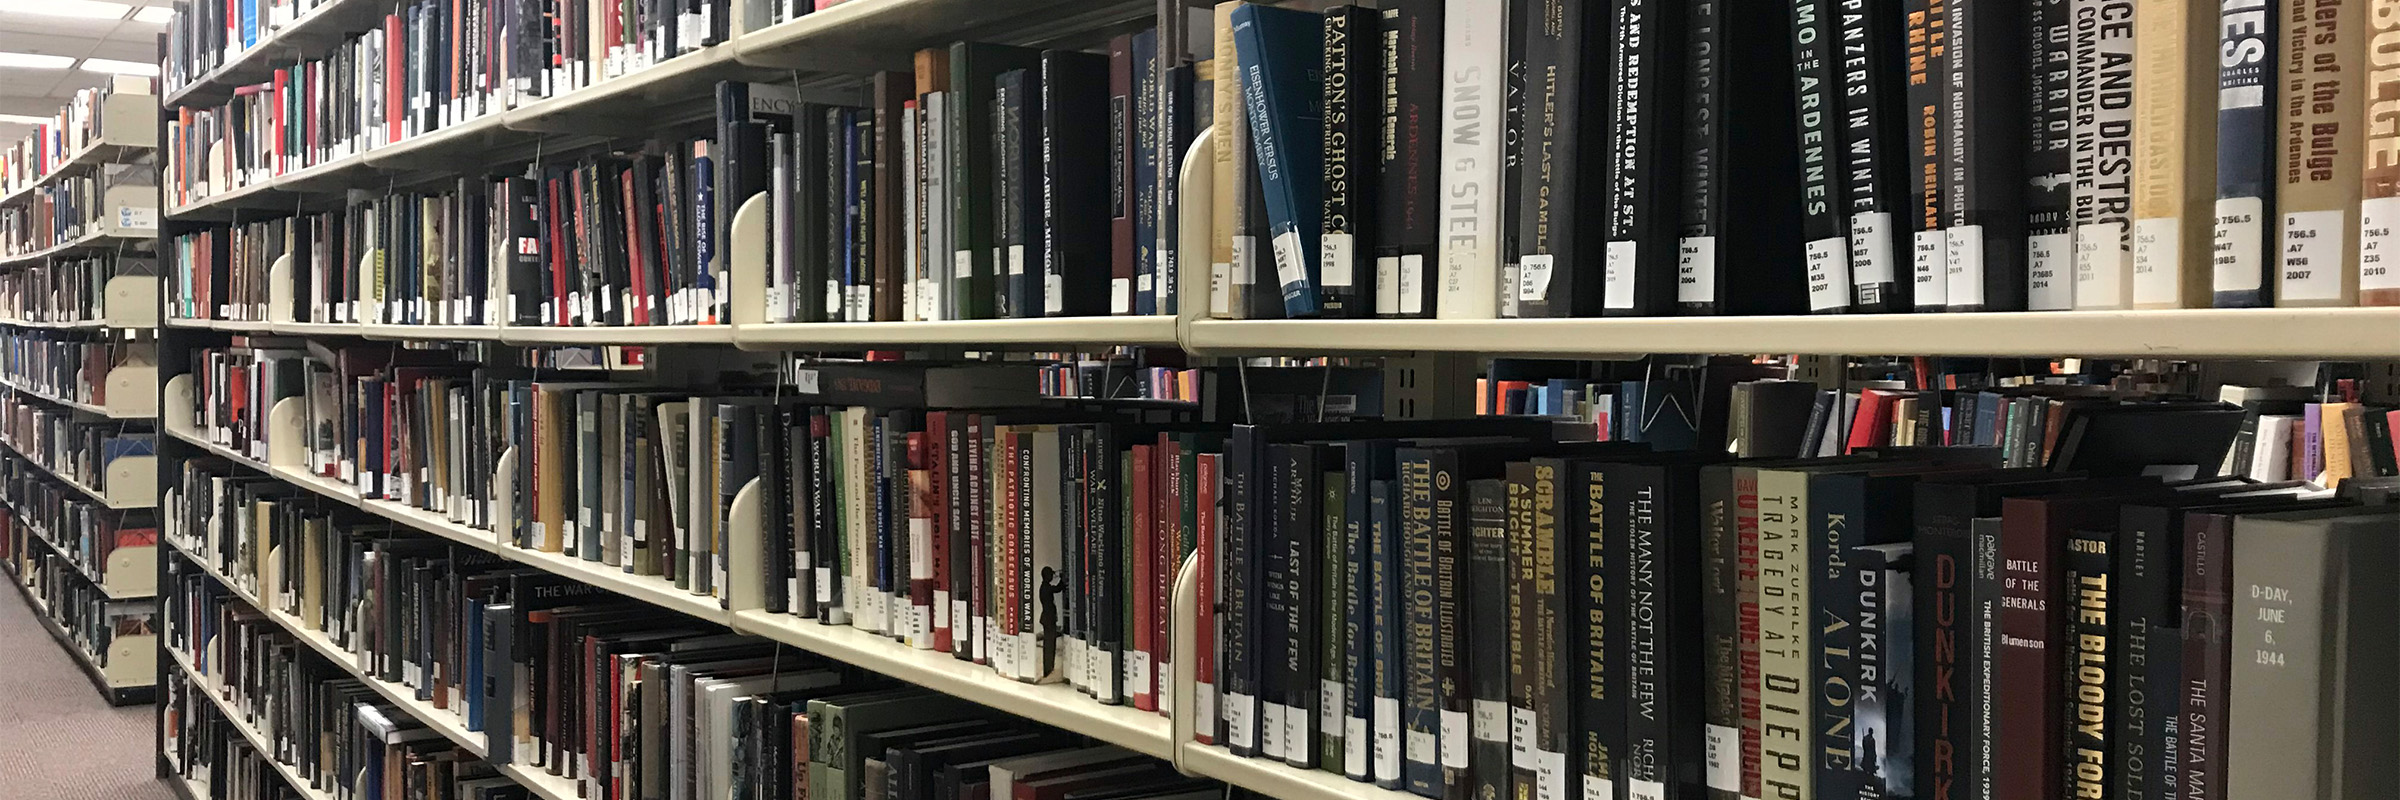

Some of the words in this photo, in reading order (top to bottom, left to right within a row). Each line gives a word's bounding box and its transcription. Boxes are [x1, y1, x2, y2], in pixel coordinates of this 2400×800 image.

[1629, 13, 1641, 48] AND
[2033, 9, 2042, 21] SS
[2293, 0, 2307, 21] and
[1324, 17, 1332, 74] CRACKING
[1388, 30, 1398, 73] Marshall
[1801, 50, 1813, 58] IN
[1841, 0, 1867, 96] PANZERS
[1909, 10, 1926, 86] RHINE
[1952, 7, 1963, 66] INVASION
[2032, 25, 2042, 70] COLONEL
[2290, 26, 2307, 74] Victory
[1218, 25, 1233, 115] MONTY'S
[1331, 14, 1346, 123] PATTON'S
[1798, 60, 1819, 70] THE
[1952, 71, 1964, 87] OF
[2076, 6, 2096, 126] COMMANDER
[2100, 52, 2133, 110] AND
[2222, 67, 2260, 78] CHARLES
[2223, 77, 2258, 85] WHITING
[2314, 52, 2340, 72] of
[1324, 75, 1332, 96] THE
[1387, 95, 1396, 114] His
[1388, 75, 1397, 93] and
[1543, 65, 1556, 138] HITLER'S
[2032, 73, 2042, 112] JOCHEN
[2049, 24, 2069, 152] WARRIOR
[2291, 79, 2304, 91] in
[2312, 79, 2340, 114] the
[2369, 0, 2400, 170] BULGE
[1249, 64, 1270, 134] EISENHOWER
[1263, 134, 1278, 181] VERSUS
[1324, 97, 1332, 153] SIEGFRIED
[1452, 65, 1481, 146] SNOW
[1506, 60, 1520, 168] VALOR
[1624, 54, 1639, 170] REDEMPTION
[1850, 108, 1869, 129] IN
[2290, 95, 2306, 116] the
[1217, 123, 1232, 163] MEN
[1245, 87, 1265, 167] MONTGOMERY
[1386, 115, 1396, 161] Generals
[1800, 77, 1826, 216] ARDENNES
[1924, 105, 1936, 156] ROBIN
[1952, 90, 1964, 164] NORMANDY
[2032, 116, 2042, 152] PEIPER
[2076, 131, 2094, 152] IN
[1330, 131, 1346, 206] GHOST
[1540, 140, 1551, 182] LAST
[2076, 155, 2093, 189] THE
[2289, 120, 2304, 184] Ardennes
[2307, 121, 2338, 181] Bulge
[1624, 175, 1635, 200] AT
[1851, 139, 1873, 213] WINTE
[1953, 167, 1964, 181] IN
[1924, 164, 1937, 231] NEILLAN
[1449, 182, 1478, 257] STEE
[1537, 186, 1549, 255] GAMBLE
[1621, 204, 1634, 235] ST.
[2288, 230, 2316, 238] 756.5
[2289, 217, 2295, 226] D
[2364, 228, 2389, 236] 756.5
[2287, 244, 2302, 252] .A7
[2287, 258, 2308, 266] W56
[2364, 242, 2378, 250] .A7
[2286, 271, 2310, 280] 2007
[2364, 268, 2385, 276] 2010
[813, 440, 822, 484] WORLD
[1022, 449, 1030, 506] CONFRONTING
[1590, 472, 1603, 482] THE
[1438, 500, 1452, 540] BATTLE
[1590, 484, 1604, 568] BATTLE
[1638, 486, 1652, 524] THE
[1790, 496, 1798, 552] MARK
[1022, 510, 1030, 554] MEMORIES
[1438, 542, 1451, 554] OF
[1535, 466, 1554, 594] SCRAMBLE
[1826, 512, 1846, 580] Korda
[2068, 538, 2106, 554] ASTOR
[1023, 556, 1030, 566] OF
[1289, 540, 1300, 576] LAST
[1638, 531, 1652, 586] MANY
[1763, 496, 1784, 616] TRAGEDY
[1978, 534, 1986, 579] macmillan
[1986, 534, 1996, 580] palgrave
[2006, 559, 2038, 572] BATTLE
[2135, 530, 2145, 577] HARTLEY
[2197, 532, 2206, 576] CASTILLO
[535, 586, 560, 598] THE
[564, 584, 592, 596] WAR
[1288, 580, 1299, 599] OF
[1439, 556, 1454, 599] BRITAIN
[1590, 574, 1604, 605] OF
[2006, 578, 2016, 590] OF
[2022, 579, 2039, 591] THE
[2252, 585, 2293, 604] D-DAY,
[1288, 602, 1298, 626] THE
[1639, 590, 1653, 634] NOT
[1790, 564, 1800, 660] ZUEHLKE
[2002, 596, 2045, 611] GENERALS
[2080, 574, 2107, 625] THE
[2258, 608, 2284, 622] JUNE
[1288, 630, 1298, 671] FEW
[1590, 610, 1604, 700] BRITAIN
[1640, 636, 1653, 676] THE
[1766, 630, 1784, 658] AT
[1860, 570, 1876, 702] DUNKIRK
[2002, 634, 2044, 649] Blumenson
[2130, 617, 2146, 666] THE
[2264, 630, 2276, 646] 6,
[1936, 554, 1955, 800] DUNKIRK
[2256, 649, 2284, 666] 1944
[1640, 680, 1654, 721] FEW
[1822, 607, 1852, 772] ALONE
[1983, 661, 1991, 738] EXPEDITIONARY
[2078, 635, 2106, 740] BLOODY
[2128, 674, 2146, 740] LOST
[2191, 679, 2206, 708] THE
[2190, 714, 2206, 764] SANTA
